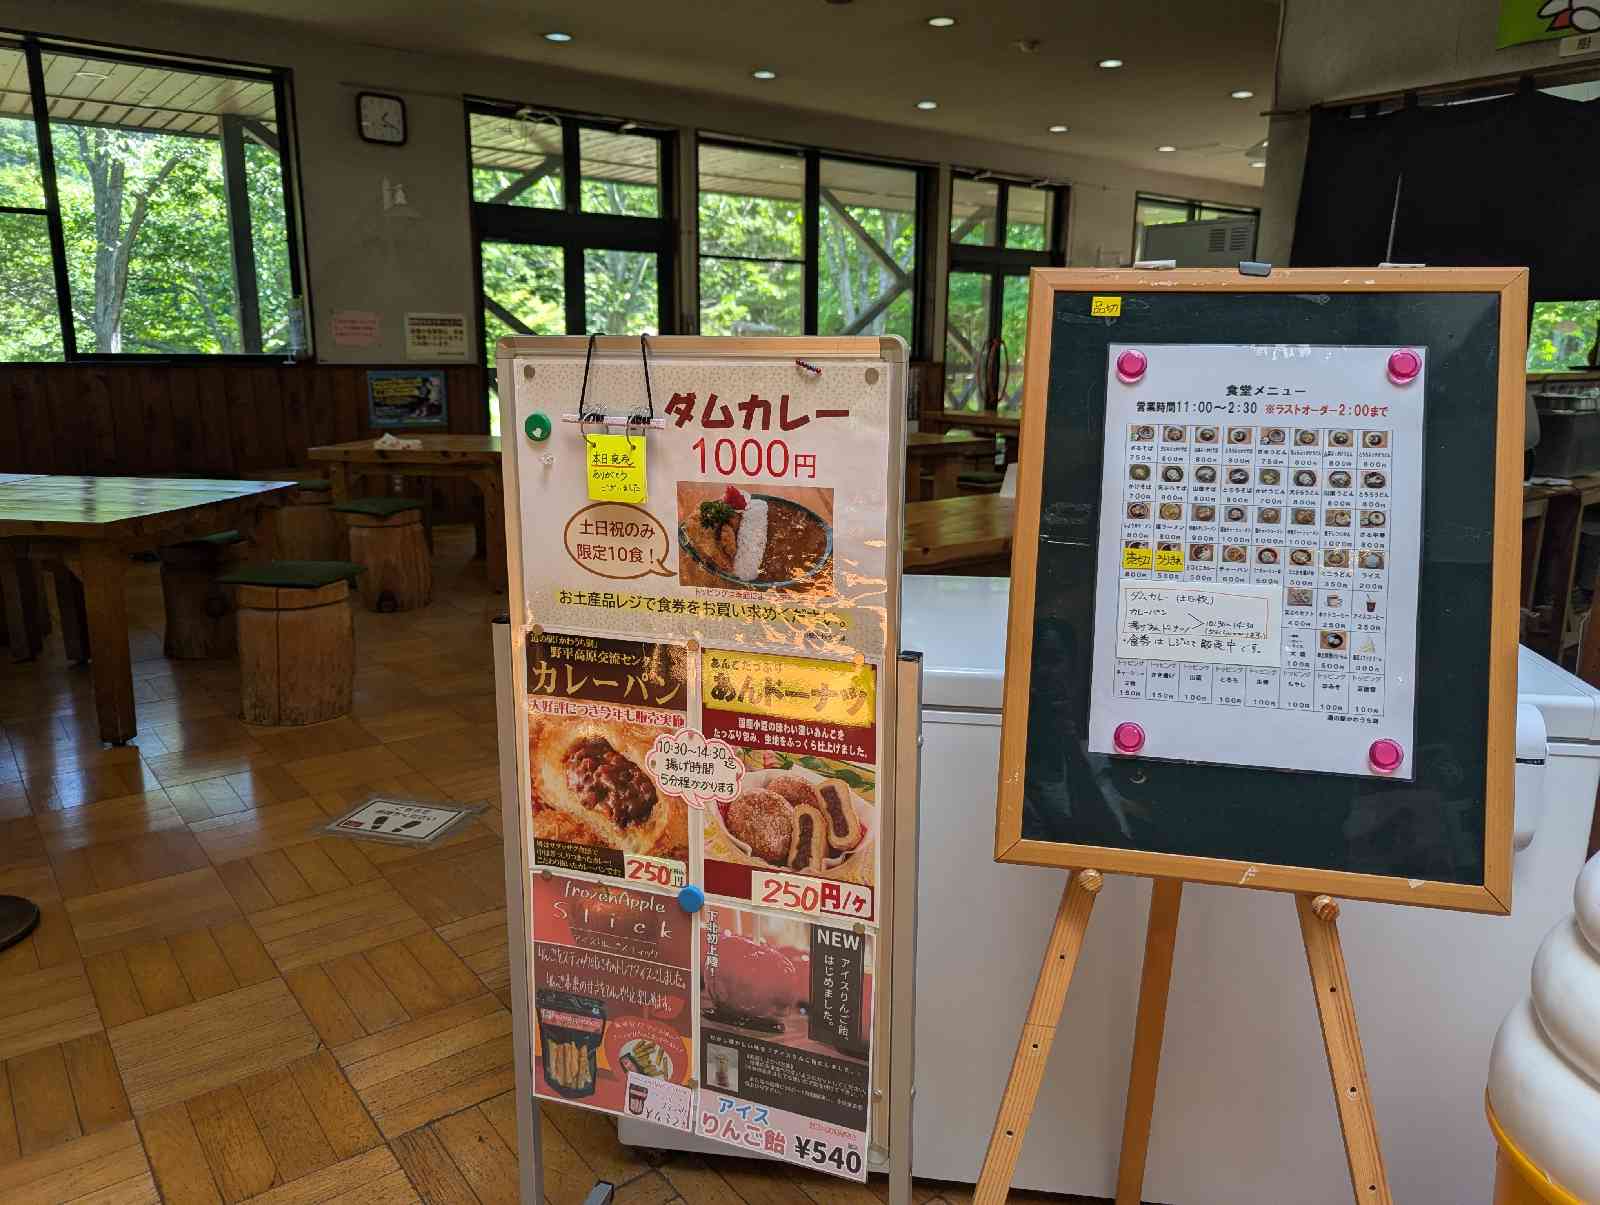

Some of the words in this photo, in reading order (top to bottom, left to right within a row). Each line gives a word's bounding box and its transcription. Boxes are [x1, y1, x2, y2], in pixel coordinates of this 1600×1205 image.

[1225, 385, 1306, 397] 食堂メニュー
[664, 391, 850, 431] ダムカレー
[692, 437, 817, 479] 1000円
[579, 519, 656, 539] 土日祝のみ
[532, 660, 682, 705] カレーパン
[664, 758, 715, 776] 揚げ時間
[660, 773, 735, 795] 5分程かかります
[627, 859, 673, 886] 250
[817, 928, 860, 951] NEW
[823, 954, 834, 1027] はじめました。
[719, 1097, 770, 1126] アイス
[702, 1112, 786, 1156] りんご飴
[794, 1135, 862, 1174] ¥540
